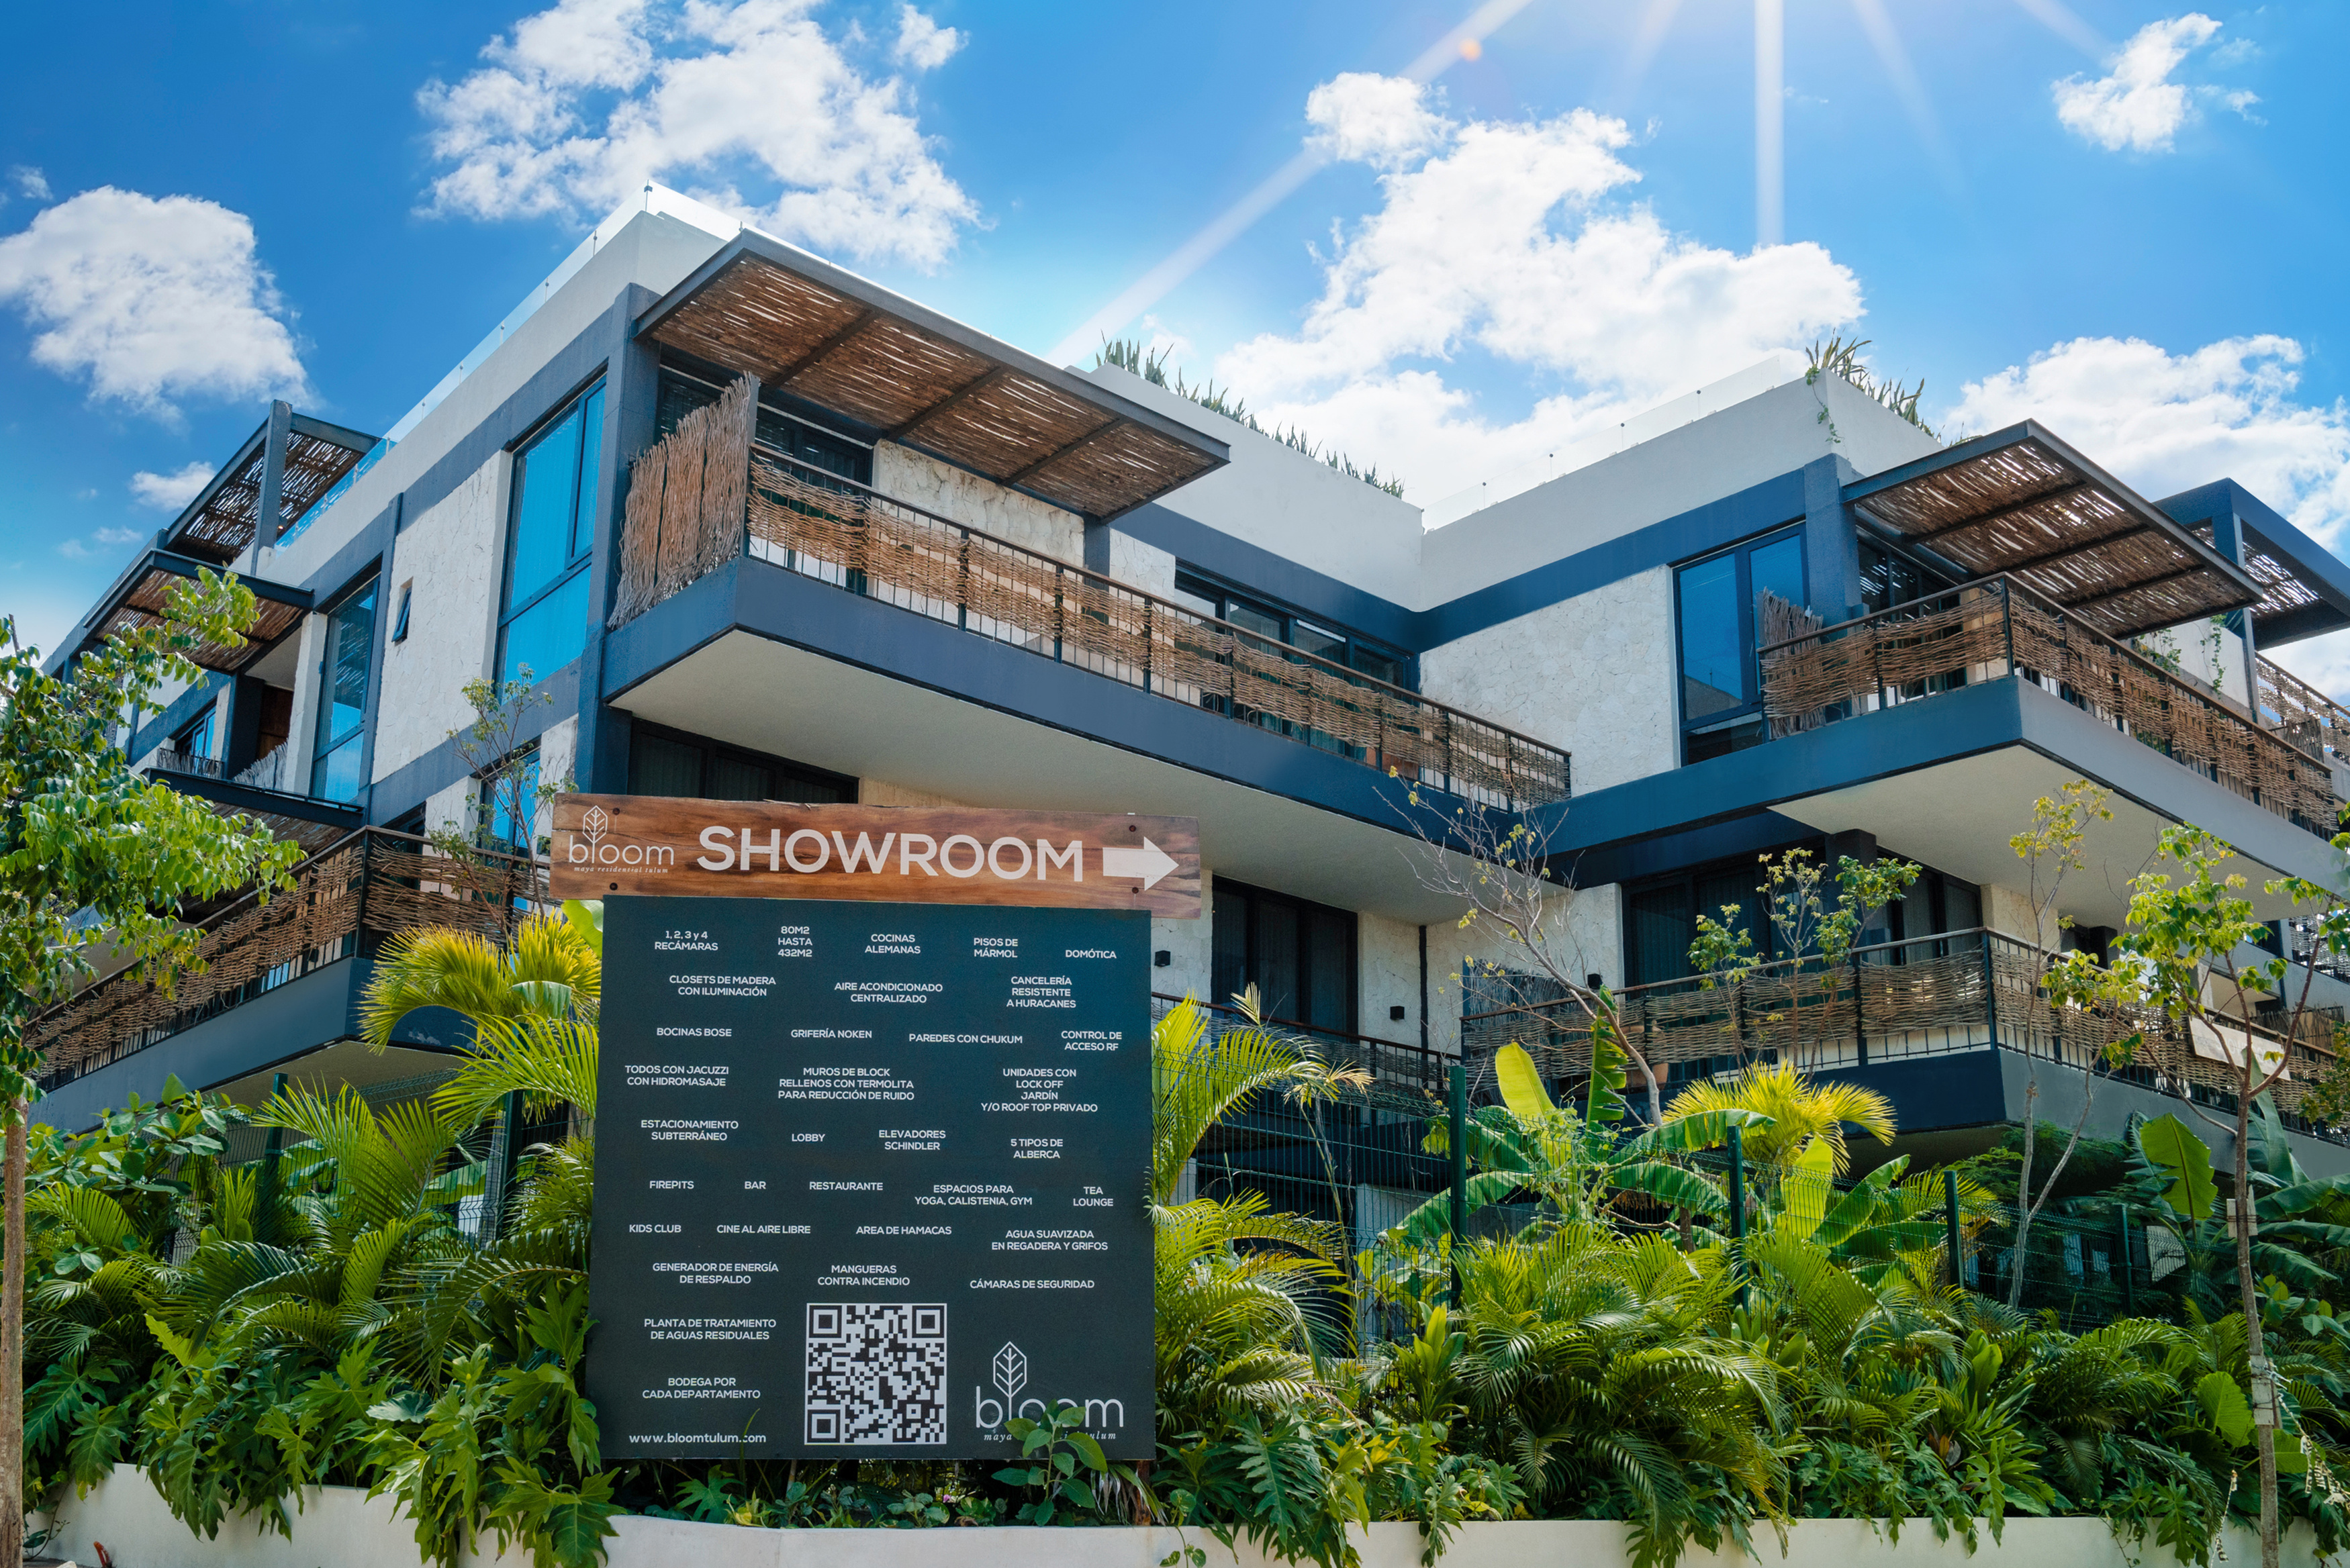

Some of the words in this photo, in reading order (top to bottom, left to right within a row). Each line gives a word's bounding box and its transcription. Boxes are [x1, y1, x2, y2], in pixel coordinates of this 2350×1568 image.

[569, 834, 675, 866] bloom
[696, 825, 1084, 883] SHOWROOM
[780, 926, 810, 934] 80M2
[693, 932, 700, 941] y
[700, 931, 708, 940] 4
[870, 934, 916, 943] COCINAS
[654, 940, 718, 951] RECÁMARAS
[778, 937, 813, 946] HASTA
[974, 937, 1004, 946] PISOS
[1005, 938, 1019, 947] DE
[778, 948, 812, 957] 432M2
[864, 945, 921, 954] ALEMANAS
[974, 947, 1018, 959] MÁRMOL
[1065, 948, 1117, 959] DOMÓTICA
[669, 975, 716, 984] CLOSETS
[717, 975, 731, 984] DE
[732, 976, 777, 985] MADERA
[1010, 975, 1072, 985] CANCELERÍA
[677, 986, 700, 995] CON
[702, 985, 767, 997] ILUMINACIÓN
[834, 981, 858, 991] AIRE
[858, 982, 943, 993] ACONDICIONADO
[1012, 987, 1071, 997] RESISTENTE
[850, 993, 927, 1003] CENTRALIZADO
[1006, 999, 1015, 1008] A
[1015, 999, 1076, 1008] HURACANES
[657, 1027, 702, 1036] BOCINAS
[704, 1028, 732, 1037] BOSE
[790, 1028, 837, 1038] GRIFERÍA
[837, 1030, 872, 1039] NOKEN
[1061, 1030, 1108, 1040] CONTROL
[1109, 1031, 1123, 1040] DE
[908, 1033, 955, 1043] PAREDES
[956, 1034, 979, 1043] CON
[980, 1034, 1023, 1044] CHUKUM
[1064, 1042, 1105, 1051] ACCESO
[1106, 1042, 1119, 1051] RF
[624, 1065, 661, 1074] TODOS
[662, 1065, 685, 1074] CON
[686, 1065, 729, 1075] JACUZZI
[803, 1067, 841, 1077] MUROS
[842, 1067, 856, 1076] DE
[857, 1068, 890, 1077] BLOCK
[1002, 1068, 1053, 1077] UNIDADES
[1055, 1069, 1076, 1077] CON
[626, 1077, 650, 1085] CON
[651, 1077, 726, 1087] HIDROMASAJE
[779, 1079, 832, 1088] RELLENOS
[833, 1079, 855, 1088] CON
[857, 1079, 914, 1089] TERMOLITA
[1016, 1079, 1043, 1089] LOCK
[1043, 1079, 1064, 1089] OFF
[778, 1090, 808, 1099] PARA
[808, 1089, 867, 1100] REDUCCIÓN
[867, 1091, 882, 1100] DE
[883, 1091, 915, 1101] RUIDO
[1021, 1089, 1058, 1100] JARDÍN
[980, 1102, 1000, 1112] Y/O
[1001, 1102, 1030, 1112] ROOF
[1031, 1103, 1052, 1112] TOP
[1053, 1103, 1098, 1112] PRIVADO
[641, 1120, 739, 1130] ESTACIONAMIENTO
[651, 1130, 728, 1141] SUBTERRÁNEO
[792, 1133, 826, 1142] LOBBY
[878, 1130, 946, 1139] ELEVADORES
[884, 1141, 941, 1150] SCHINDLER
[1010, 1138, 1017, 1147] 5
[1018, 1138, 1049, 1147] TIPOS
[1049, 1138, 1064, 1147] DE
[1013, 1150, 1061, 1159] ALBERCA
[649, 1180, 694, 1189] FIREPITS
[744, 1181, 766, 1189] BAR
[809, 1181, 884, 1191] RESTAURANTE
[933, 1184, 984, 1193] ESPACIOS
[985, 1185, 1015, 1193] PARA
[1083, 1186, 1104, 1195] TEA
[914, 1196, 947, 1206] YOGA,
[947, 1196, 1009, 1206] CALISTENIA,
[1010, 1196, 1033, 1206] GYM
[1073, 1197, 1114, 1207] LOUNGE
[629, 1224, 653, 1233] KIDS
[654, 1224, 682, 1233] CLUB
[716, 1224, 740, 1234] CINE
[741, 1225, 756, 1234] AL
[757, 1224, 781, 1234] AIRE
[782, 1225, 811, 1234] LIBRE
[855, 1226, 885, 1234] AREA
[886, 1226, 900, 1234] DE
[901, 1226, 952, 1235] HAMACAS
[1005, 1230, 1035, 1238] AGUA
[1036, 1230, 1094, 1238] SUAVIZADA
[992, 1242, 1005, 1251] EN
[1006, 1241, 1062, 1251] REGADERA
[1063, 1242, 1070, 1251] Y
[1071, 1241, 1109, 1251] GRIFOS
[652, 1263, 718, 1272] GENERADOR
[718, 1263, 733, 1272] DE
[734, 1261, 780, 1272] ENERGÍA
[831, 1265, 897, 1274] MANGUERAS
[679, 1275, 694, 1283] DE
[695, 1275, 751, 1284] RESPALDO
[817, 1277, 861, 1285] CONTRA
[861, 1277, 910, 1286] INCENDIO
[970, 1278, 1021, 1289] CÁMARAS
[1022, 1280, 1036, 1289] DE
[1037, 1279, 1095, 1289] SEGURIDAD
[644, 1318, 687, 1328] PLANTA
[688, 1318, 702, 1328] DE
[703, 1318, 777, 1328] TRATAMIENTO
[651, 1330, 665, 1340] DE
[665, 1330, 704, 1340] AGUAS
[705, 1330, 770, 1340] RESIDUALES
[668, 1377, 712, 1387] BODEGA
[714, 1377, 736, 1387] POR
[642, 1389, 673, 1399] CADA
[674, 1389, 761, 1399] DEPARTAMENTO
[628, 1432, 767, 1443] www.bloomtulum.com
[984, 1434, 1013, 1443] maya
[1085, 1430, 1117, 1440] ulum
